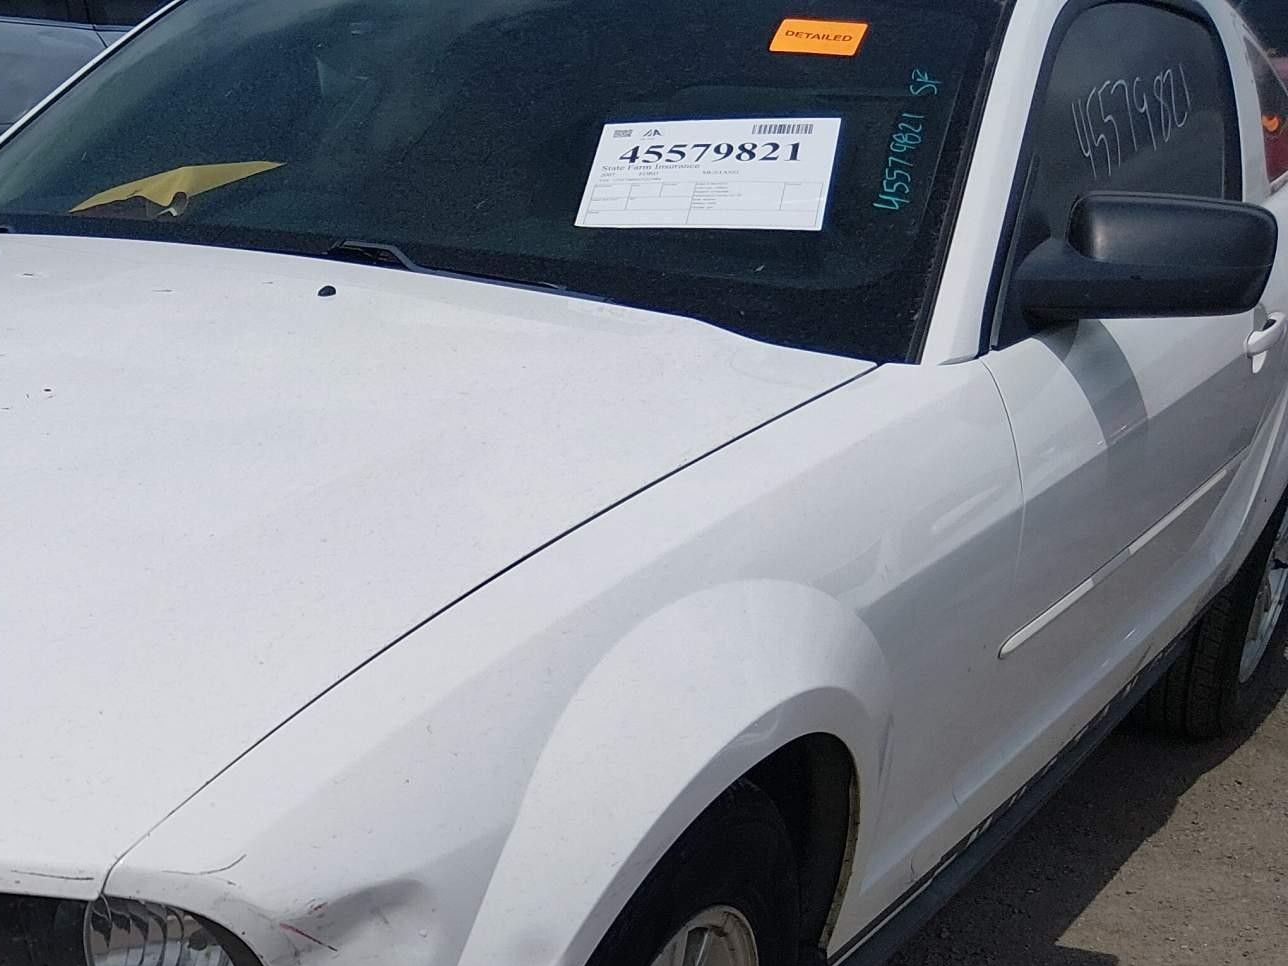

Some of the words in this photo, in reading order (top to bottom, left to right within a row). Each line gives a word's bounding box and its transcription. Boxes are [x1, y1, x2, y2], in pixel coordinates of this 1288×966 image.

[785, 30, 853, 42] DETAILED
[1072, 63, 1191, 178] 45579821
[619, 142, 801, 163] 45579821
[873, 112, 925, 210] 45579821
